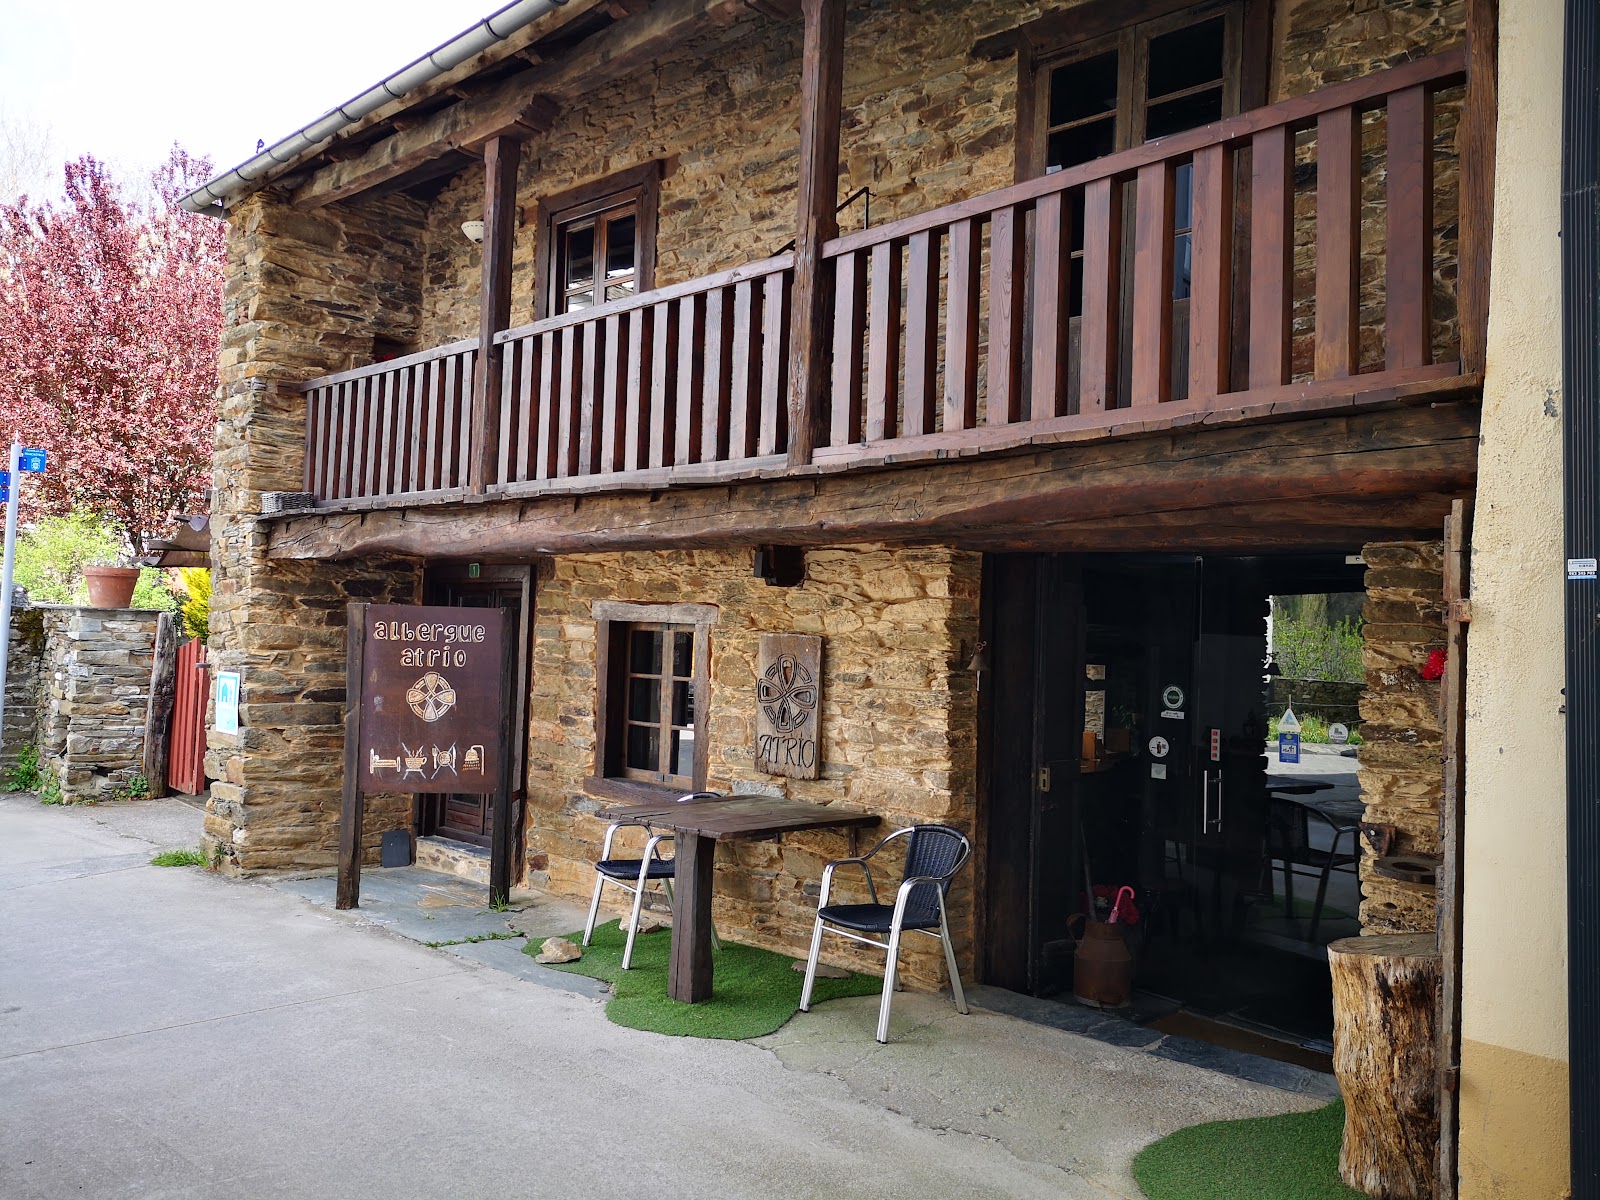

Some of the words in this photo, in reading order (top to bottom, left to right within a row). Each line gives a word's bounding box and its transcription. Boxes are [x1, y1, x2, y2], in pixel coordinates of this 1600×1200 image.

[373, 621, 486, 643] albergue
[400, 646, 467, 667] atrio
[759, 735, 815, 768] ATRIO
